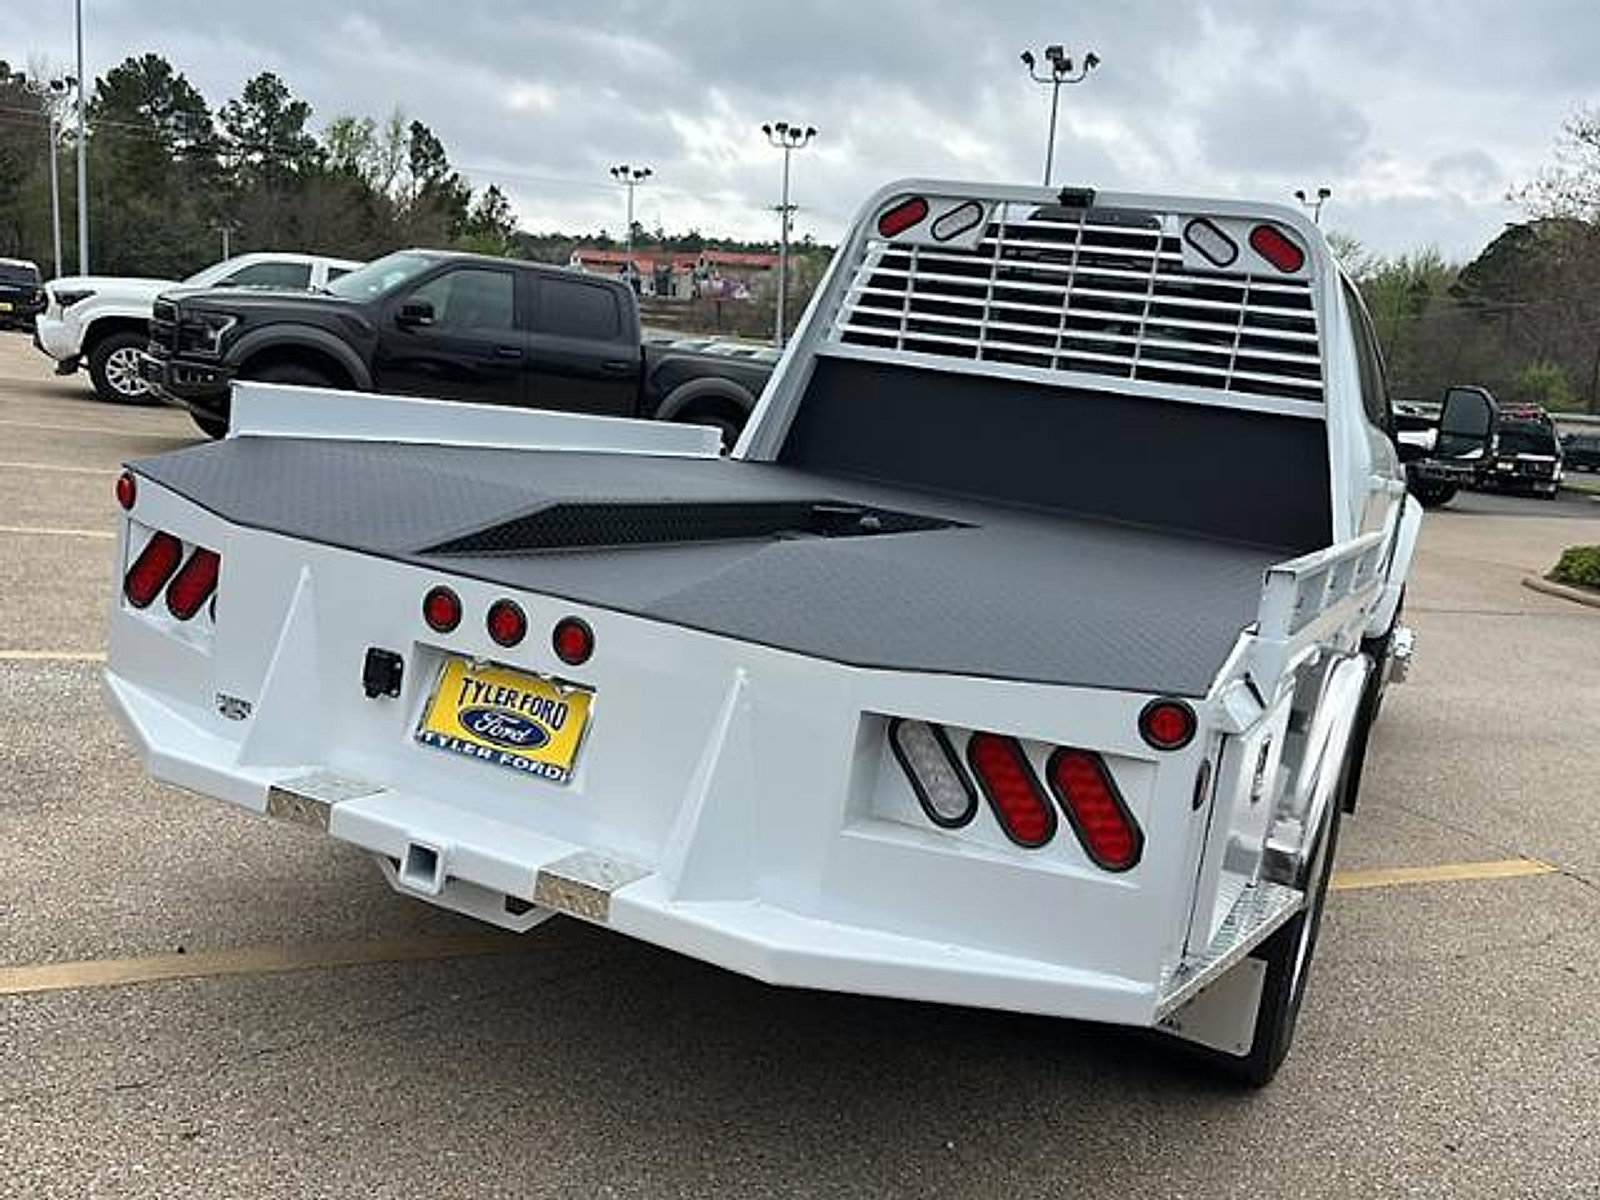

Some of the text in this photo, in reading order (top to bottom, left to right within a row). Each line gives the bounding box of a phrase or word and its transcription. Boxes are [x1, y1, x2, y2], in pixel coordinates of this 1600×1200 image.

[458, 677, 568, 731] TYLER FORD
[474, 712, 534, 742] Ford
